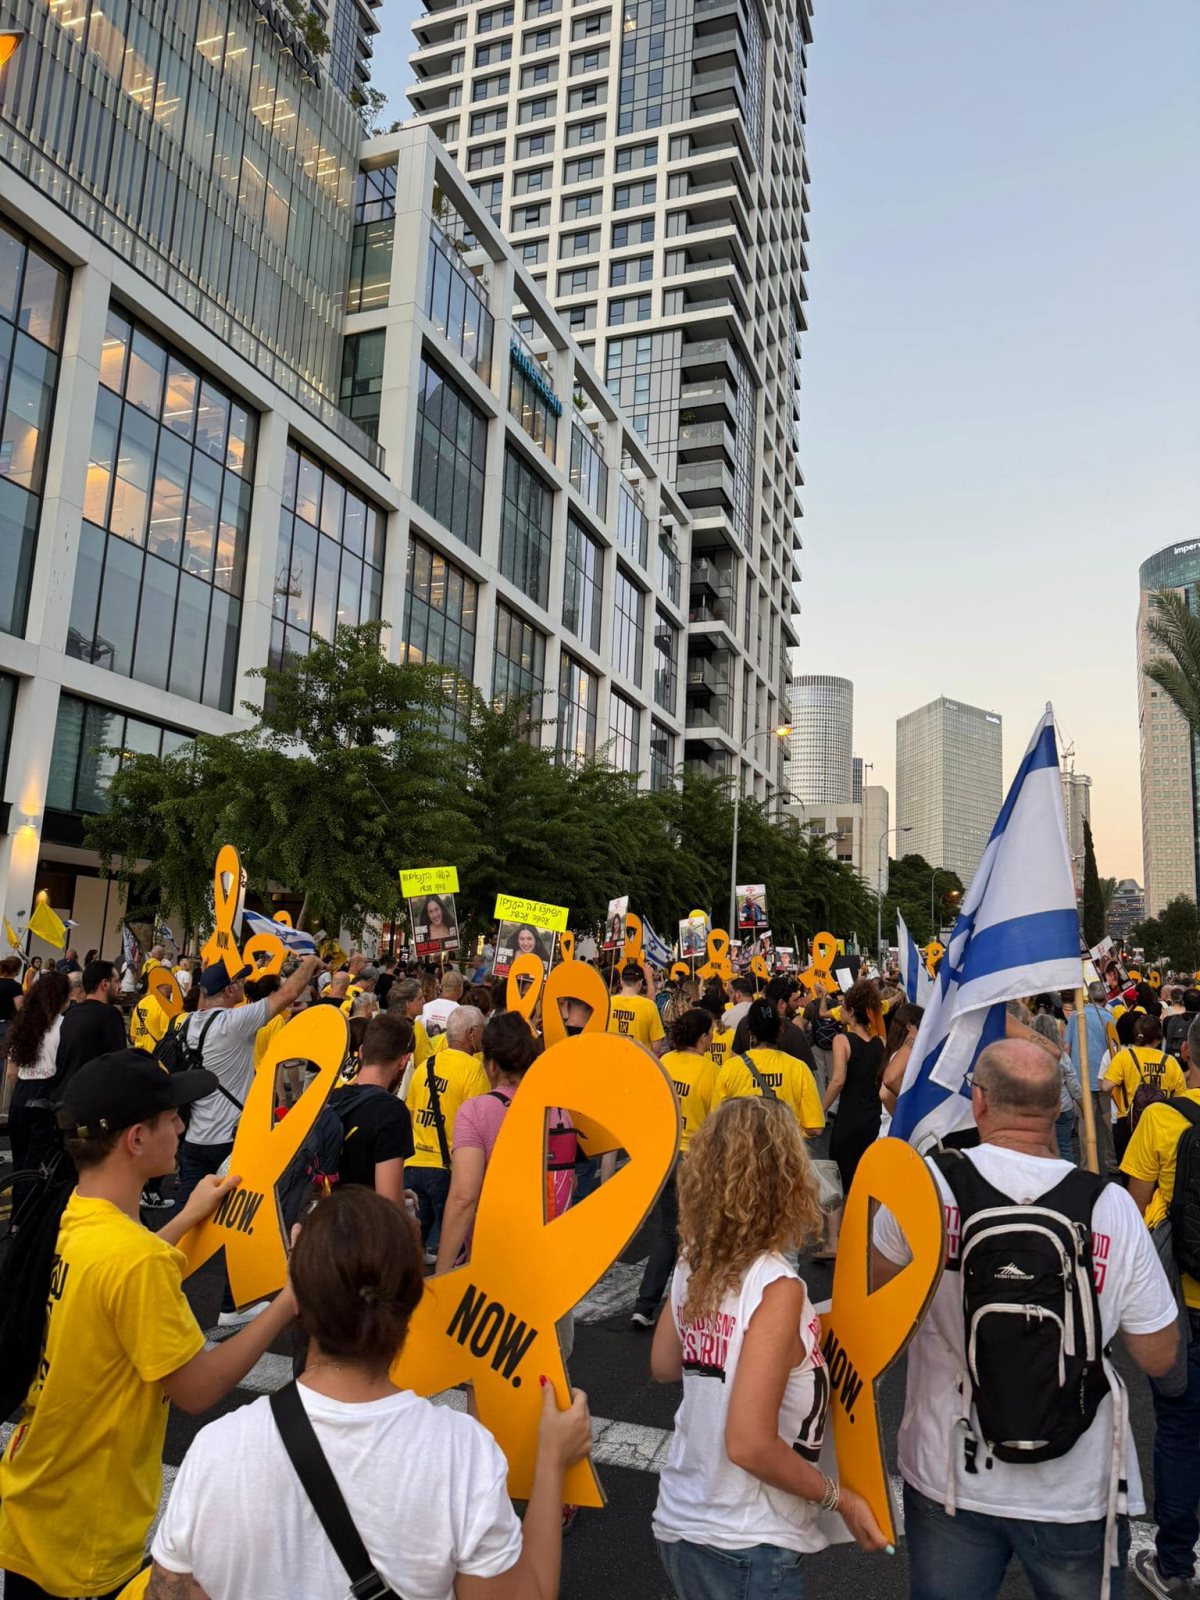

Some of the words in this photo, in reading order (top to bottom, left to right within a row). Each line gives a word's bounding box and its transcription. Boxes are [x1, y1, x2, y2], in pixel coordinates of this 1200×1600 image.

[613, 1009, 635, 1021] עסקה
[213, 1187, 264, 1235] NOW.
[446, 1283, 538, 1388] NOW.
[822, 1328, 863, 1424] NOW.
